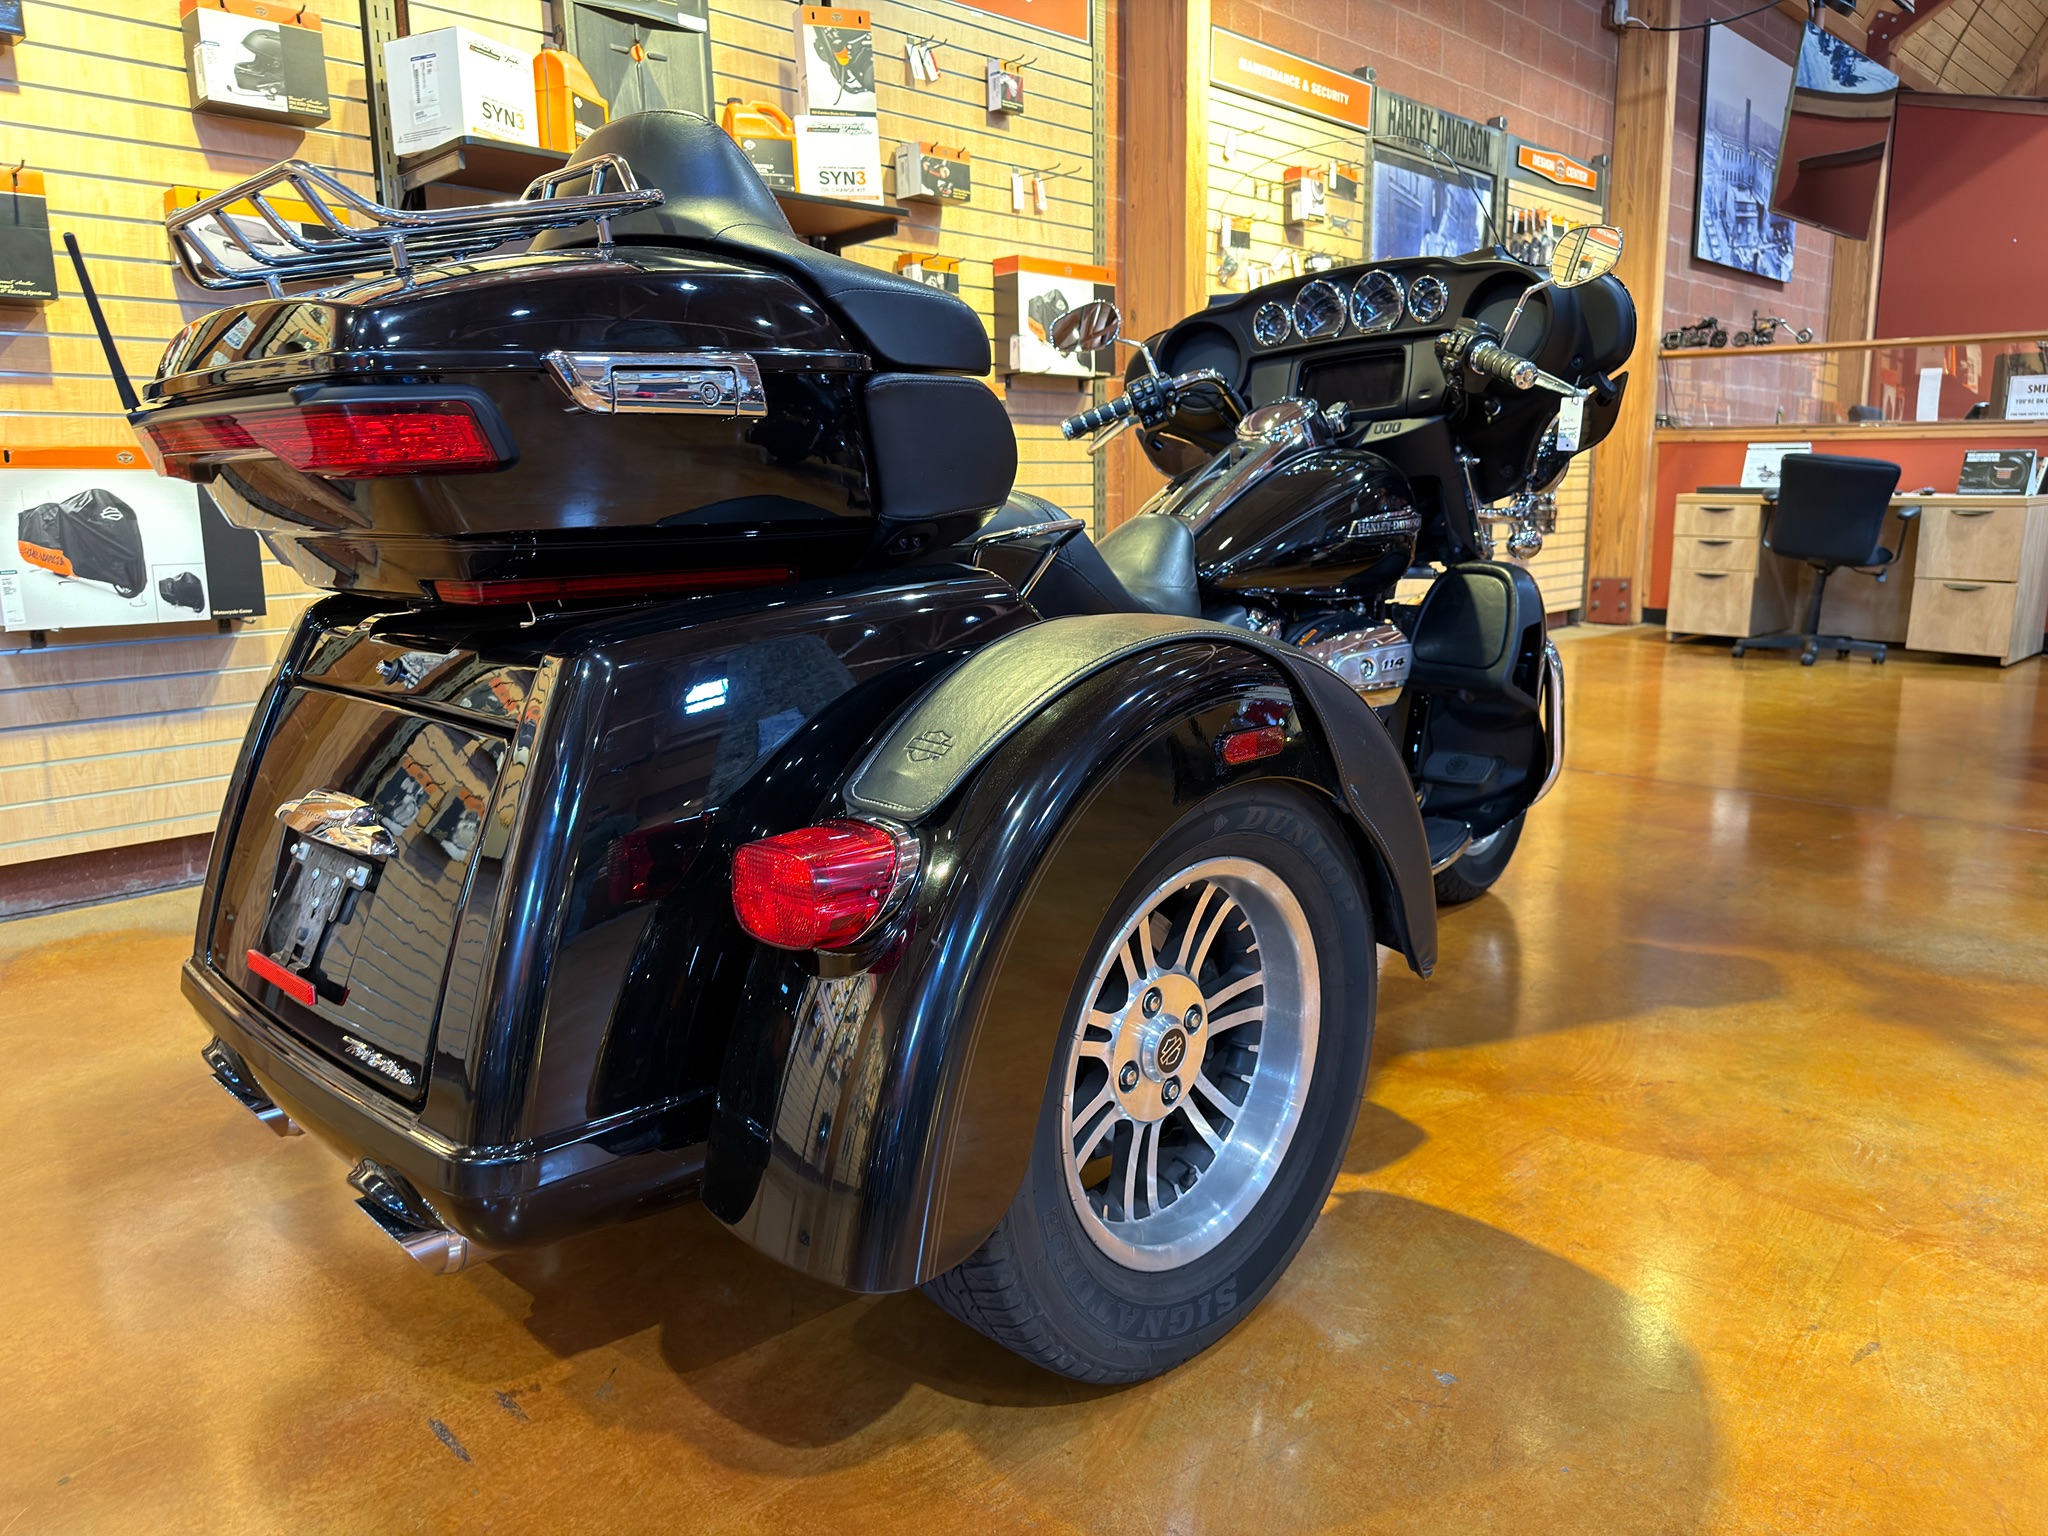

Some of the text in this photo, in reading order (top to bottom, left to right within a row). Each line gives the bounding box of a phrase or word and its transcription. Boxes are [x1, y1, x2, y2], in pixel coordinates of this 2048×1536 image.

[1238, 57, 1350, 105] MAINTENANCE & SECURITY
[482, 101, 526, 131] SYN3
[819, 170, 867, 186] SYN3
[1532, 153, 1588, 183] DESIGN CENTER
[2027, 384, 2048, 394] SMI
[1382, 656, 1407, 672] 114
